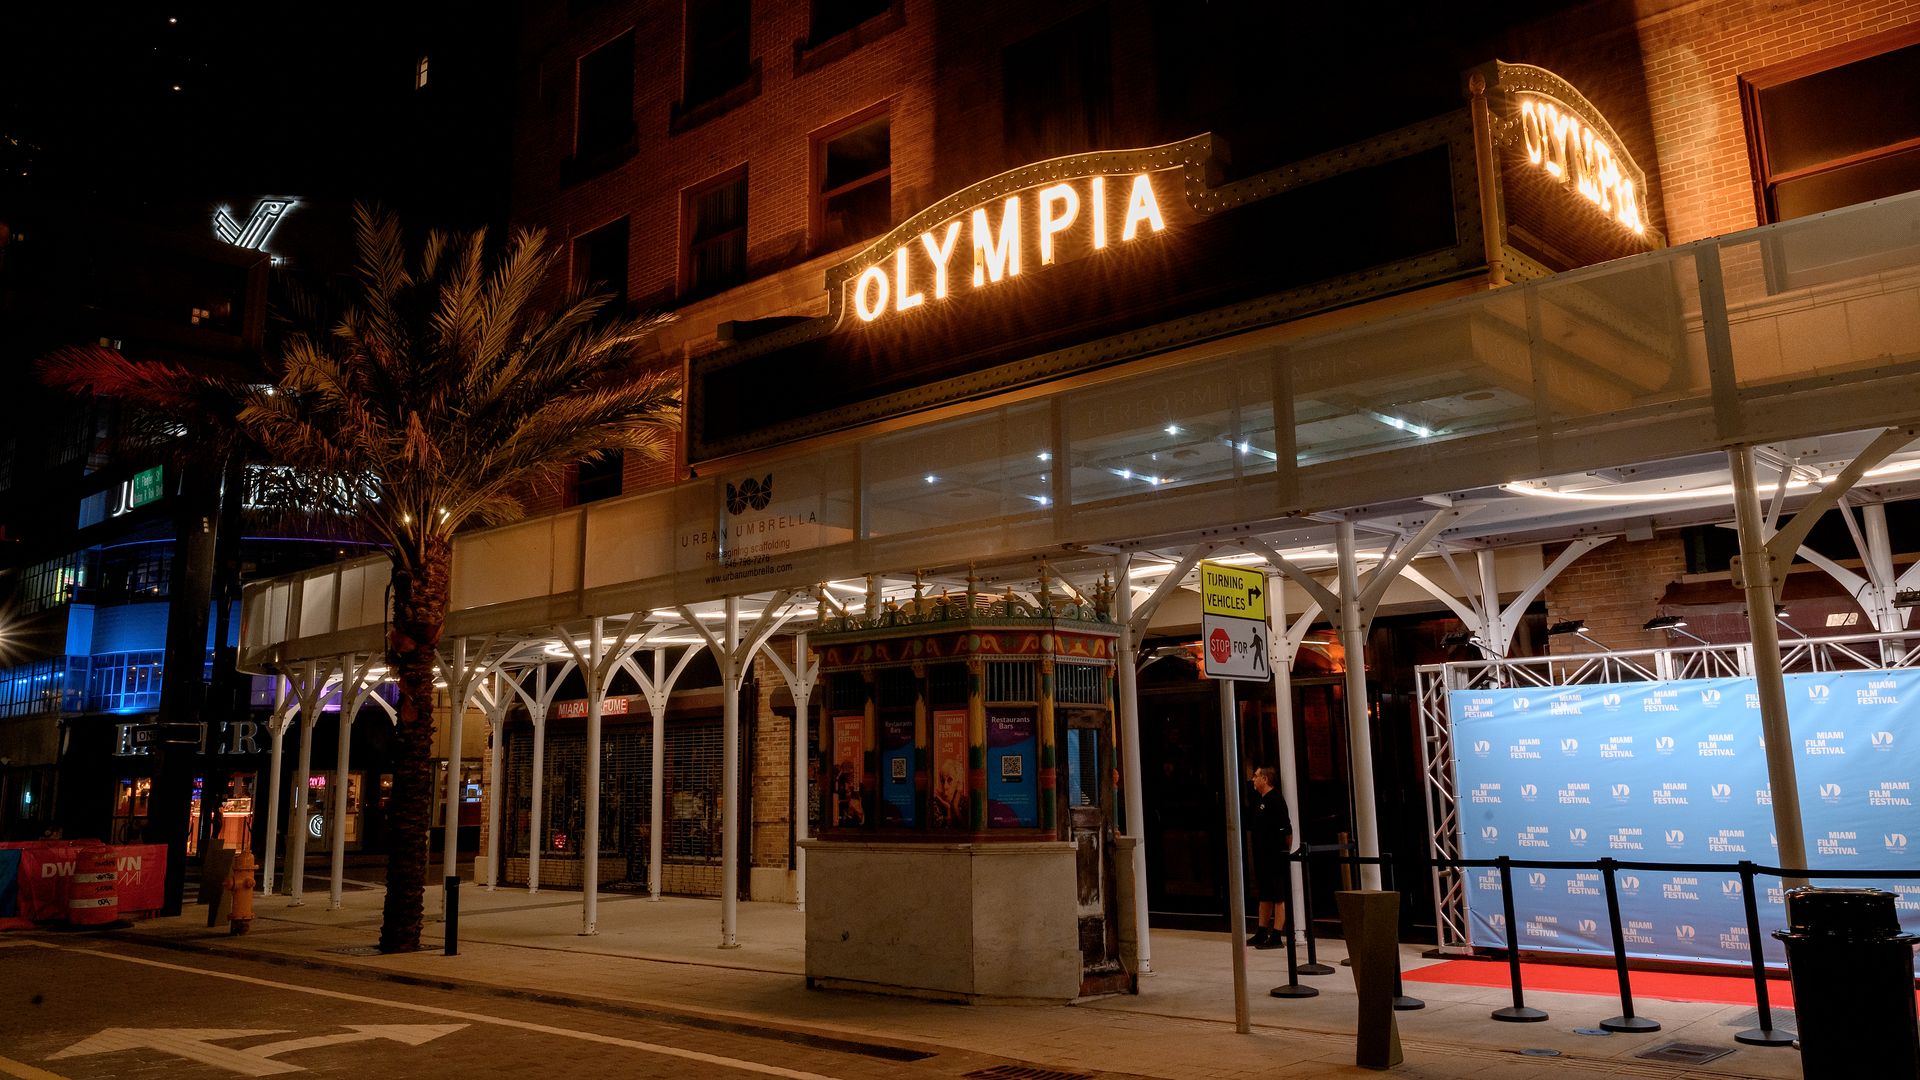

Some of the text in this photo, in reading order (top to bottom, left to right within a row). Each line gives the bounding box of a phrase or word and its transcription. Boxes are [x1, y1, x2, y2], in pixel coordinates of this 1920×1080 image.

[1522, 101, 1644, 234] OLYMPIA
[855, 172, 1166, 322] OLYMPIA
[681, 511, 817, 548] URBAN UMBRELLA
[751, 539, 791, 553] scaffolding
[705, 563, 793, 584] www.urbanumbrella.com
[1207, 572, 1244, 590] TURNING
[1207, 593, 1246, 611] VEHICLES
[1211, 638, 1248, 654] STOP FOR
[1869, 681, 1896, 689] MIAMI
[558, 702, 585, 715] MIARA
[1673, 877, 1697, 885] MIAMI
[1568, 887, 1600, 895] FESTIVAL
[1664, 892, 1699, 900] FESTIVAL
[1629, 921, 1652, 929] MIAMI
[1527, 929, 1559, 937] FESTIVAL
[1622, 936, 1654, 944] ESTIVAL
[1721, 941, 1751, 949] FESTIV
